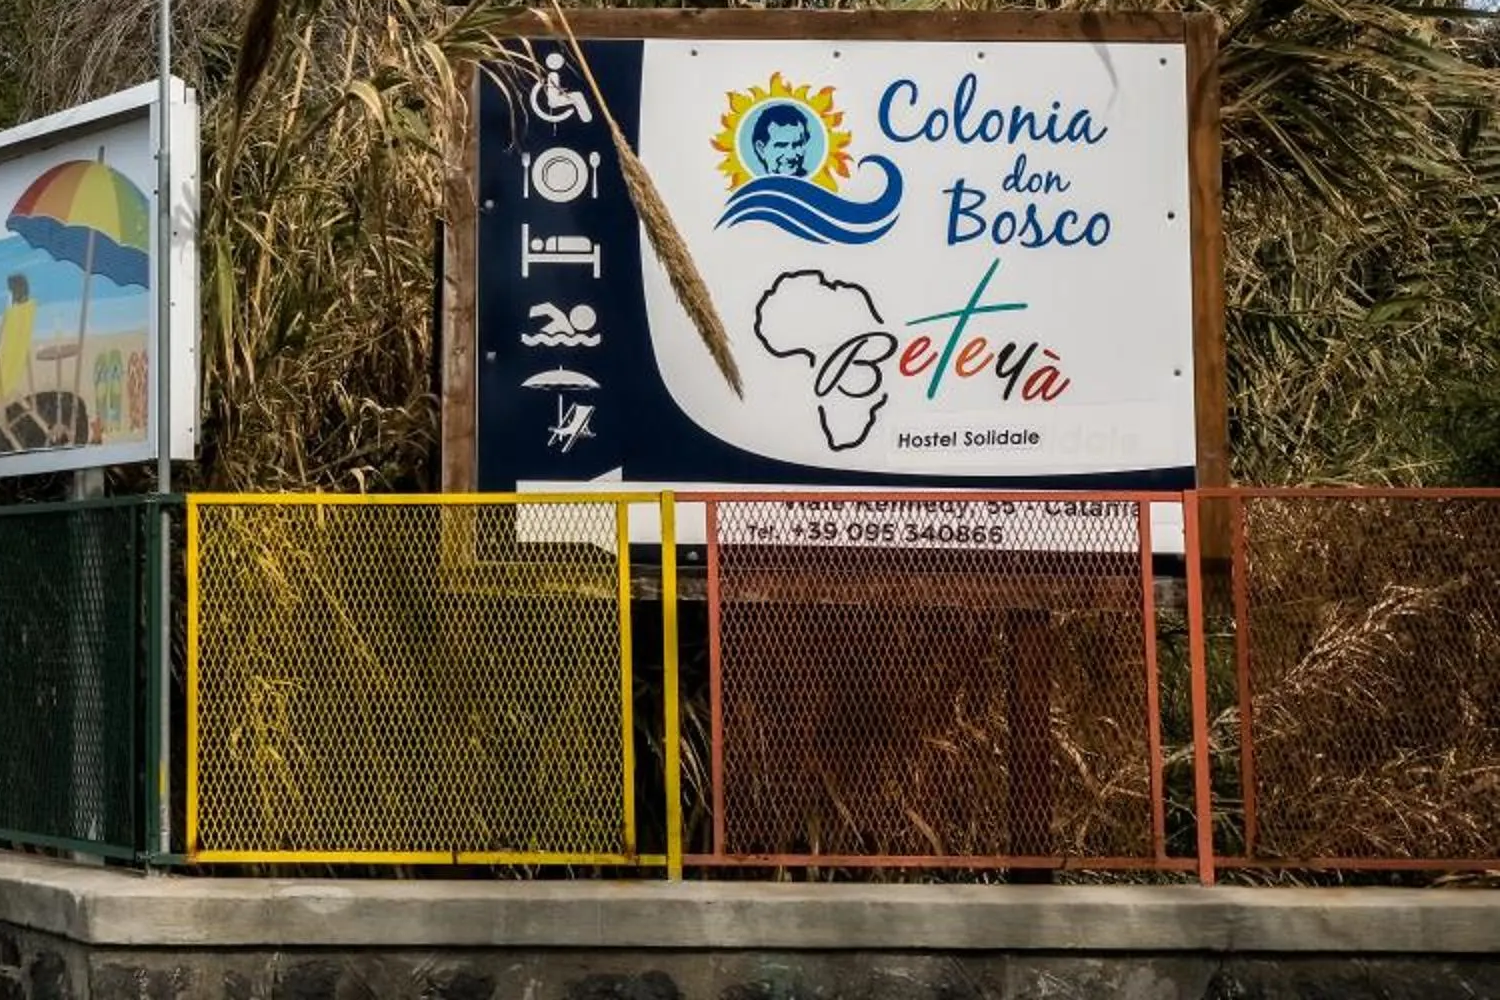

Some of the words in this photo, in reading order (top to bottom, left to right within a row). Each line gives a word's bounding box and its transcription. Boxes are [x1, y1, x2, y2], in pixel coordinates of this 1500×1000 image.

[878, 72, 1108, 144] Colonia
[1002, 153, 1071, 194] don
[942, 178, 1111, 248] Bosco
[814, 257, 1070, 402] Beteyà
[898, 431, 957, 448] Hostel
[963, 429, 1041, 447] Solidale
[749, 525, 780, 540] Tel.
[793, 521, 838, 541] +39
[848, 522, 895, 542] 095
[905, 524, 1003, 544] 340866
